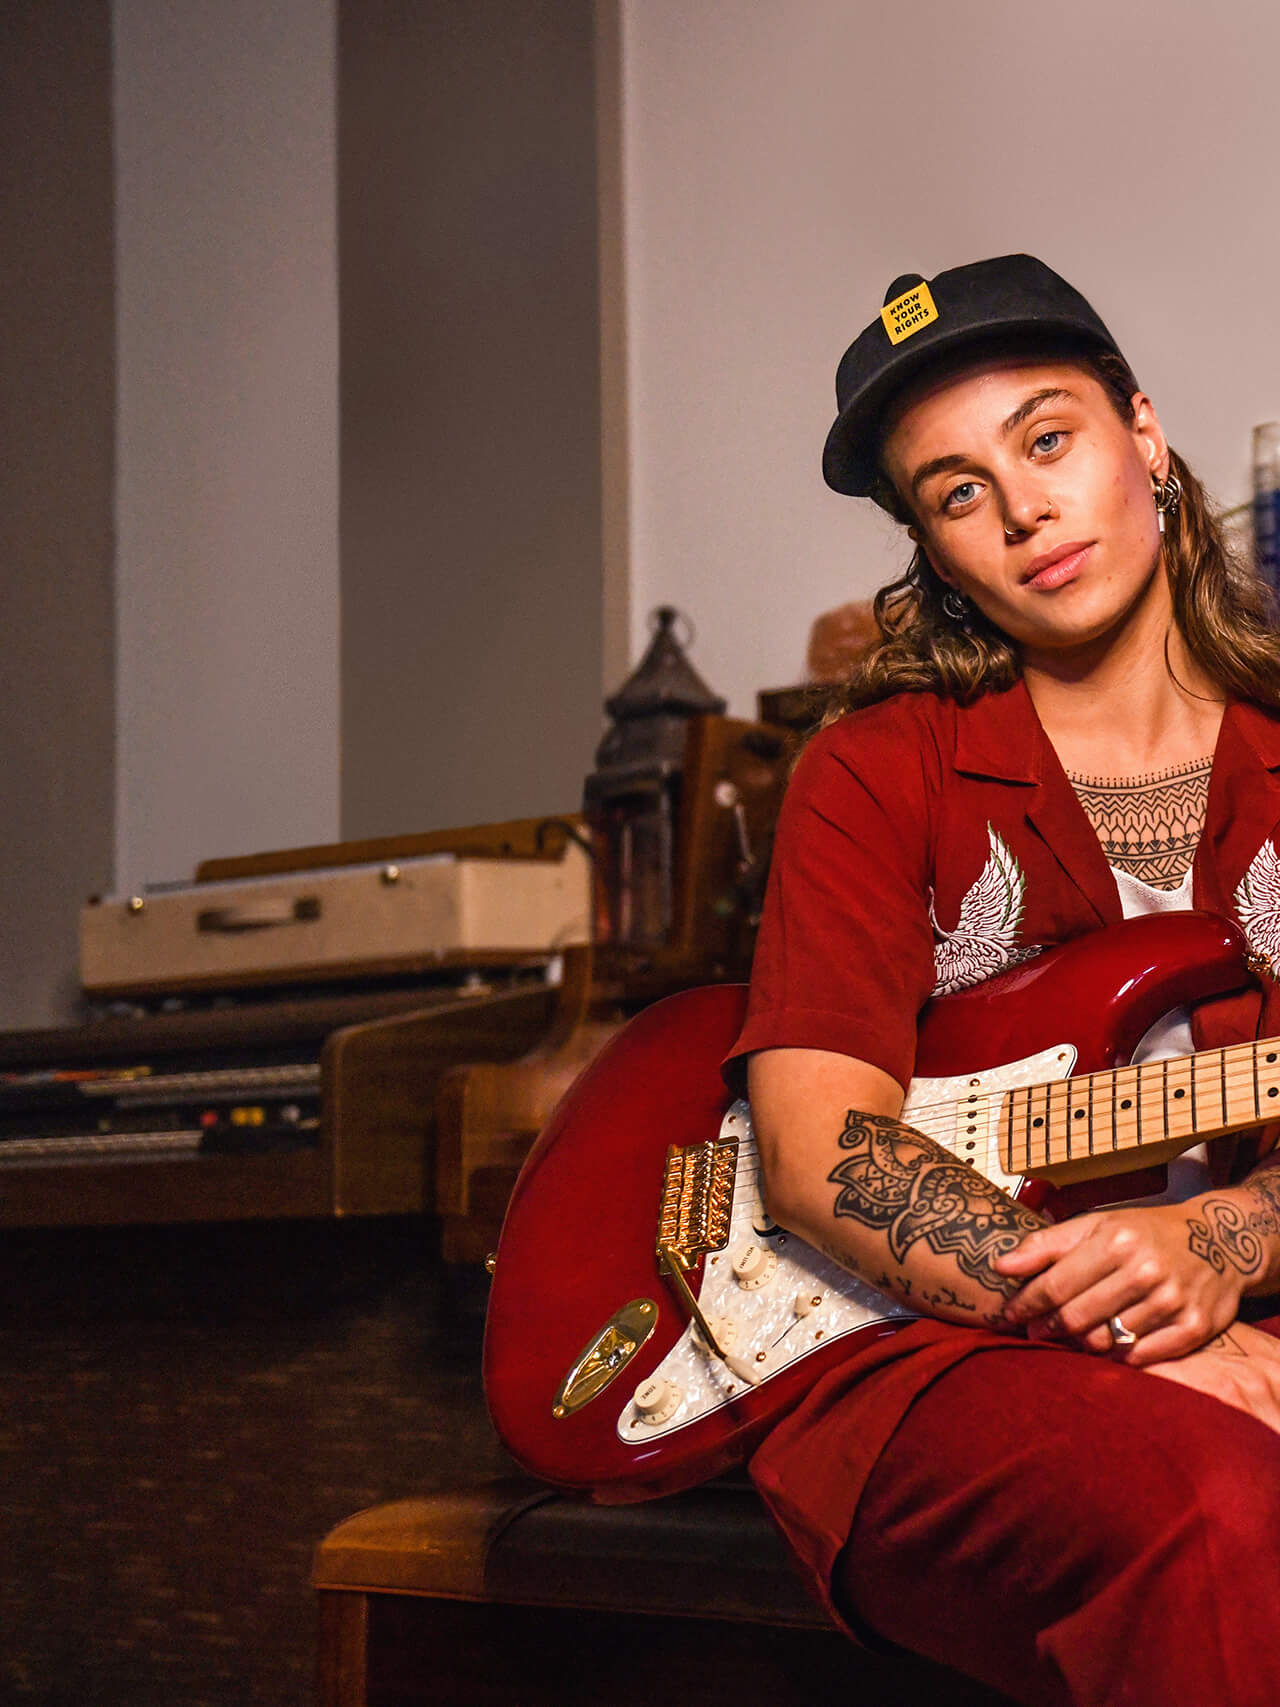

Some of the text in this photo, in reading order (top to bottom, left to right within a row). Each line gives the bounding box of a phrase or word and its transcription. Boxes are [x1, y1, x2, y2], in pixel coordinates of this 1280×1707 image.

[890, 292, 919, 316] KNOW
[894, 303, 921, 322] YOUR
[894, 308, 929, 335] RIGHTS
